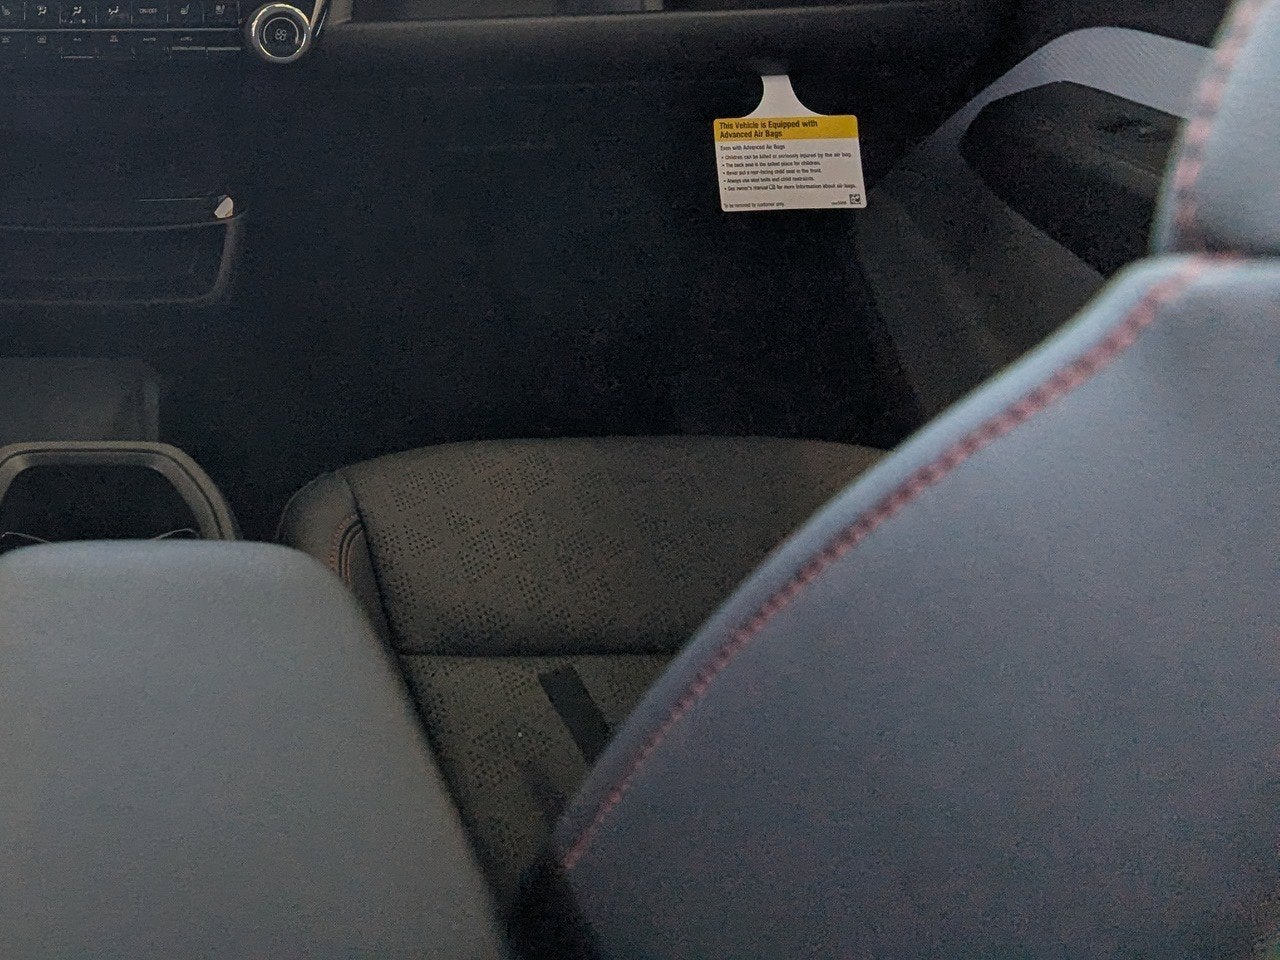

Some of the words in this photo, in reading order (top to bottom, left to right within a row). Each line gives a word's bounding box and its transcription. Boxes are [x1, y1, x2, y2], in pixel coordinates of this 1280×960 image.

[768, 120, 799, 129] Equipped
[720, 130, 752, 138] Advanced
[754, 130, 763, 138] Air
[765, 130, 782, 138] Bags
